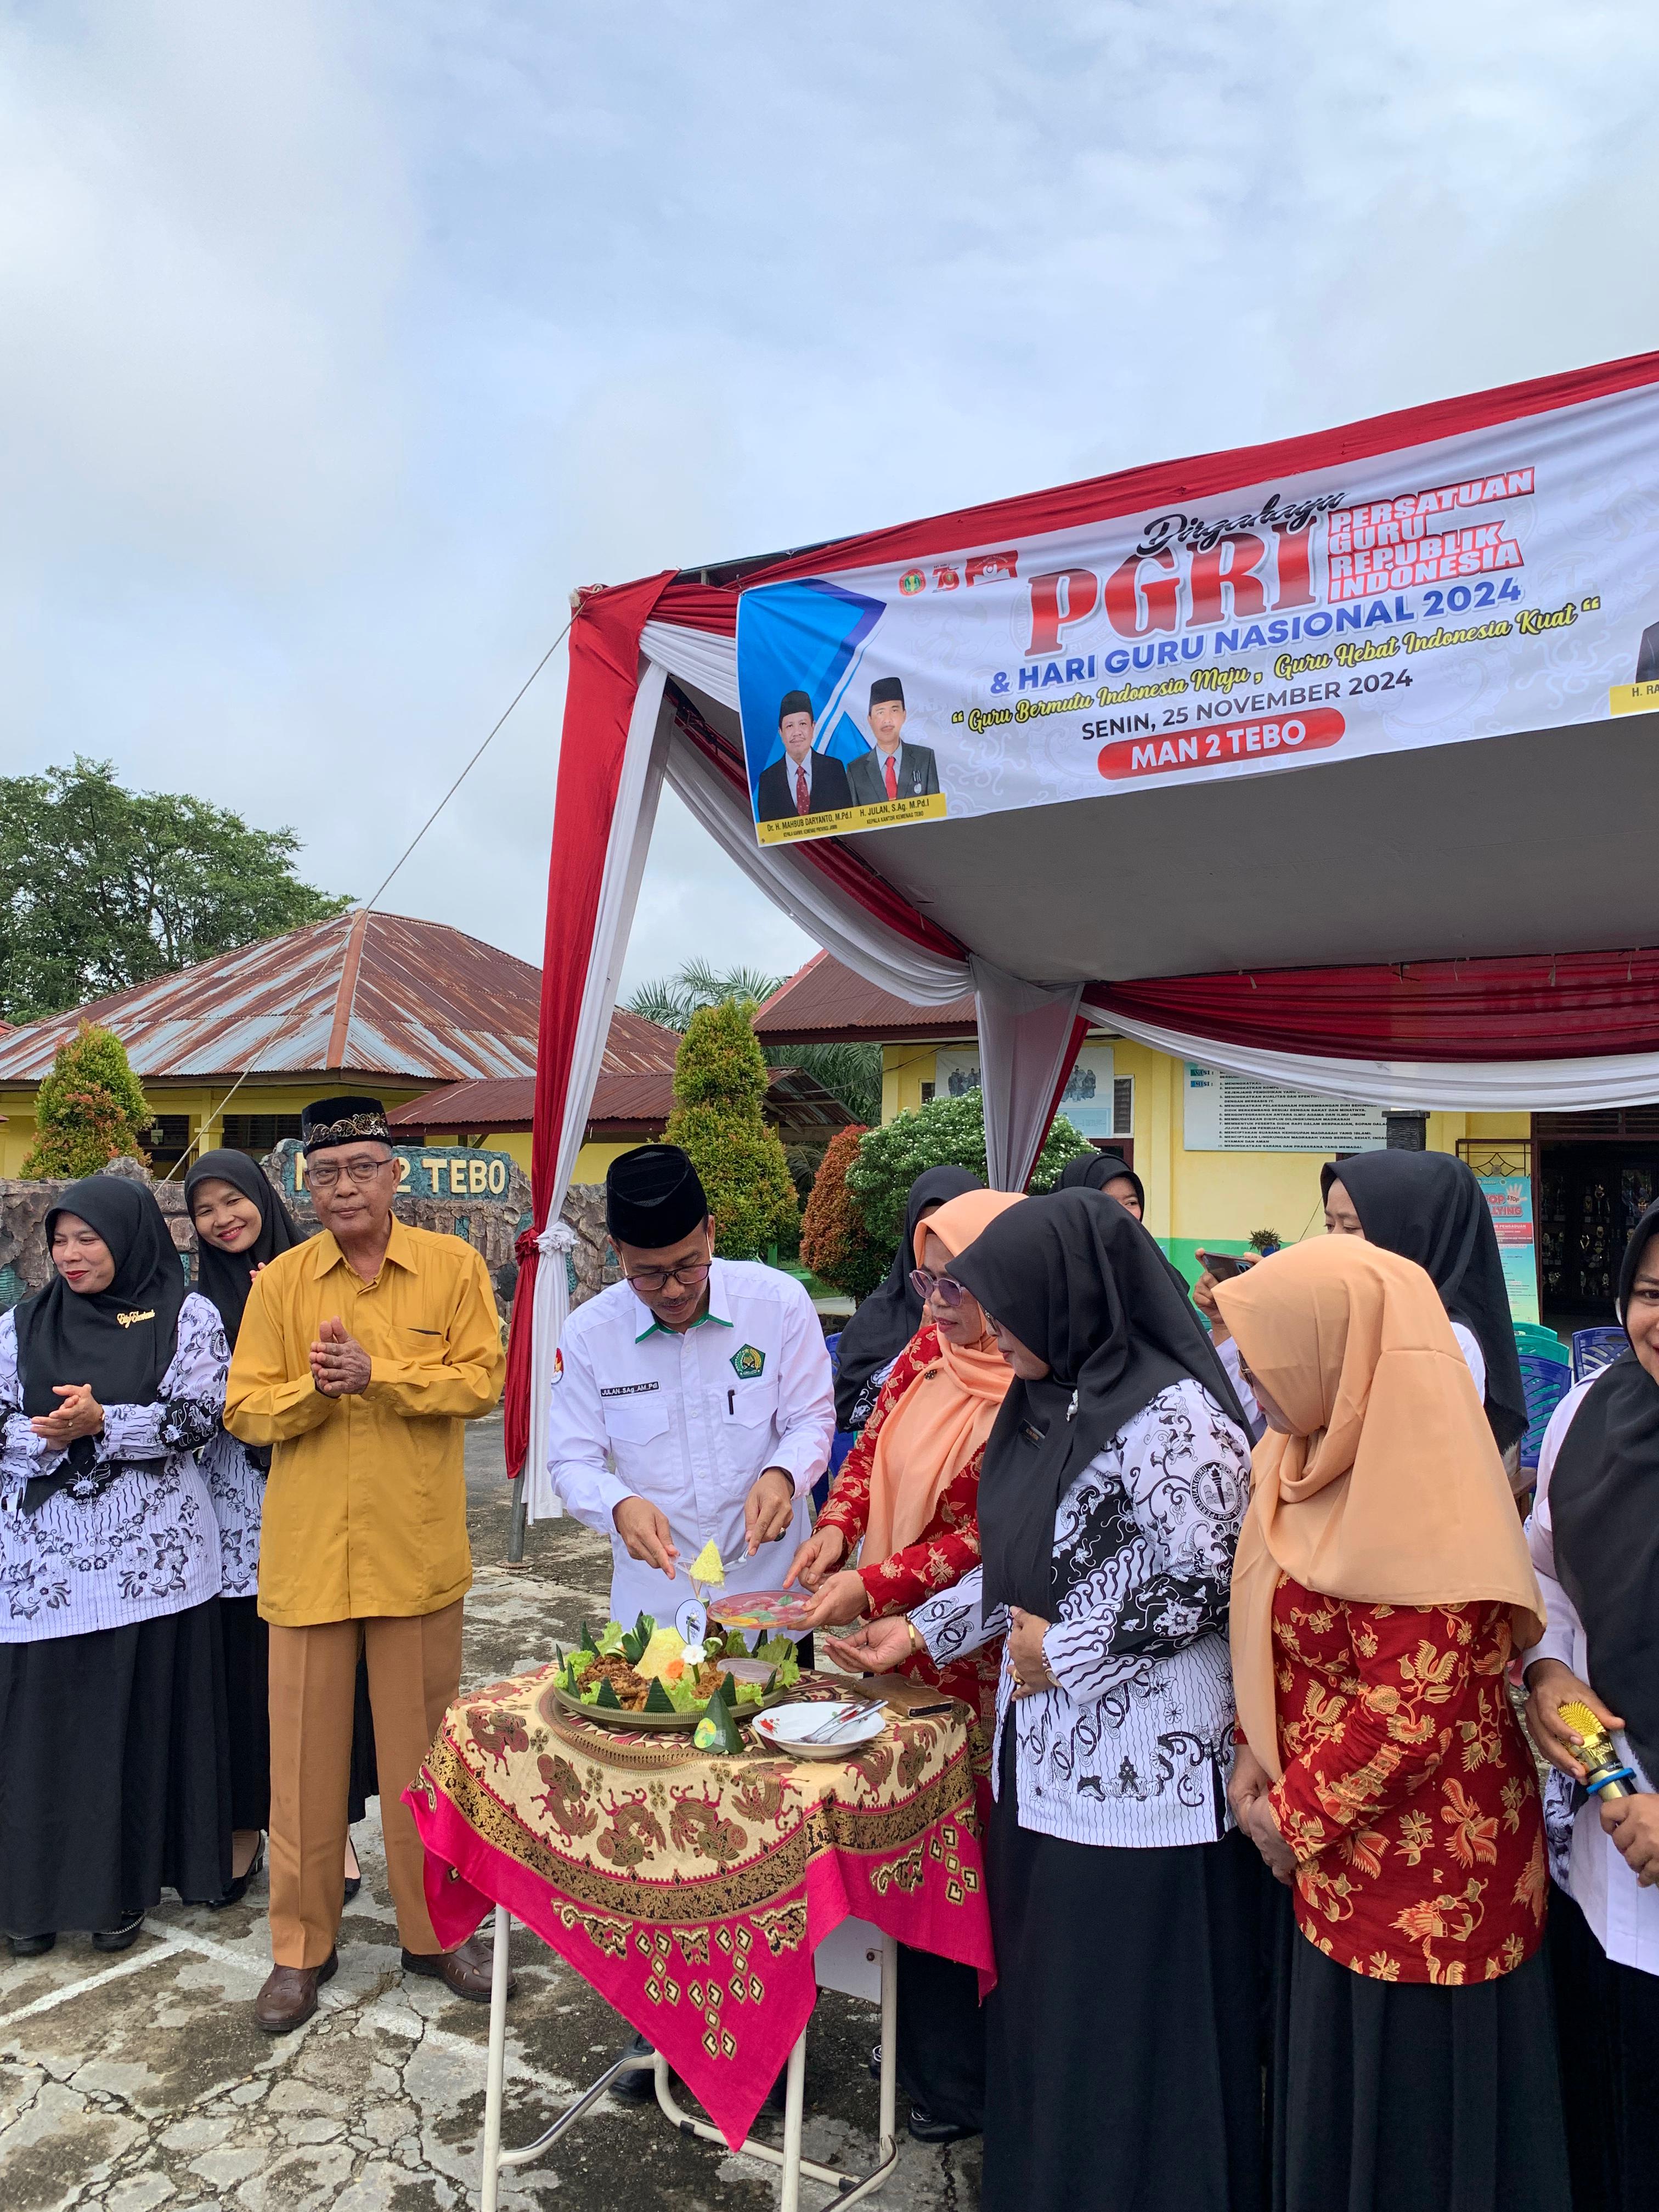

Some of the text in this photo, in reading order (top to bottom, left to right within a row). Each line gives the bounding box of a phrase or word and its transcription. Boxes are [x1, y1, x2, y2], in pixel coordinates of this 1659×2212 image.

[1137, 493, 1345, 556] Dirgahayu
[1329, 469, 1534, 534] PERSATUAN
[1329, 515, 1426, 556] GURU
[1330, 524, 1504, 580] REPUBLIK
[1024, 516, 1316, 657] PGRI
[1329, 541, 1521, 602] INDONESIA
[990, 672, 1010, 694] &
[1018, 655, 1095, 691] HARI
[1104, 635, 1204, 674] GURU
[1215, 596, 1414, 654] NASIONAL
[1423, 577, 1521, 617] 2024
[968, 708, 1013, 733] Guru
[1015, 692, 1094, 723] Bermutu
[1097, 679, 1188, 708] Indonesia
[1190, 667, 1251, 693] Maju
[1274, 653, 1333, 680] Guru
[1334, 636, 1400, 668] Hebat
[1402, 620, 1513, 654] Indonesia
[1515, 602, 1578, 635] Kuat
[1632, 687, 1643, 697] H.
[1082, 668, 1413, 740] SENIN, 25 NOVEMBER 2024
[1131, 719, 1306, 770] MAN 2 TEBO
[422, 1158, 506, 1194] TEBO
[1193, 1465, 1207, 1482] GURU
